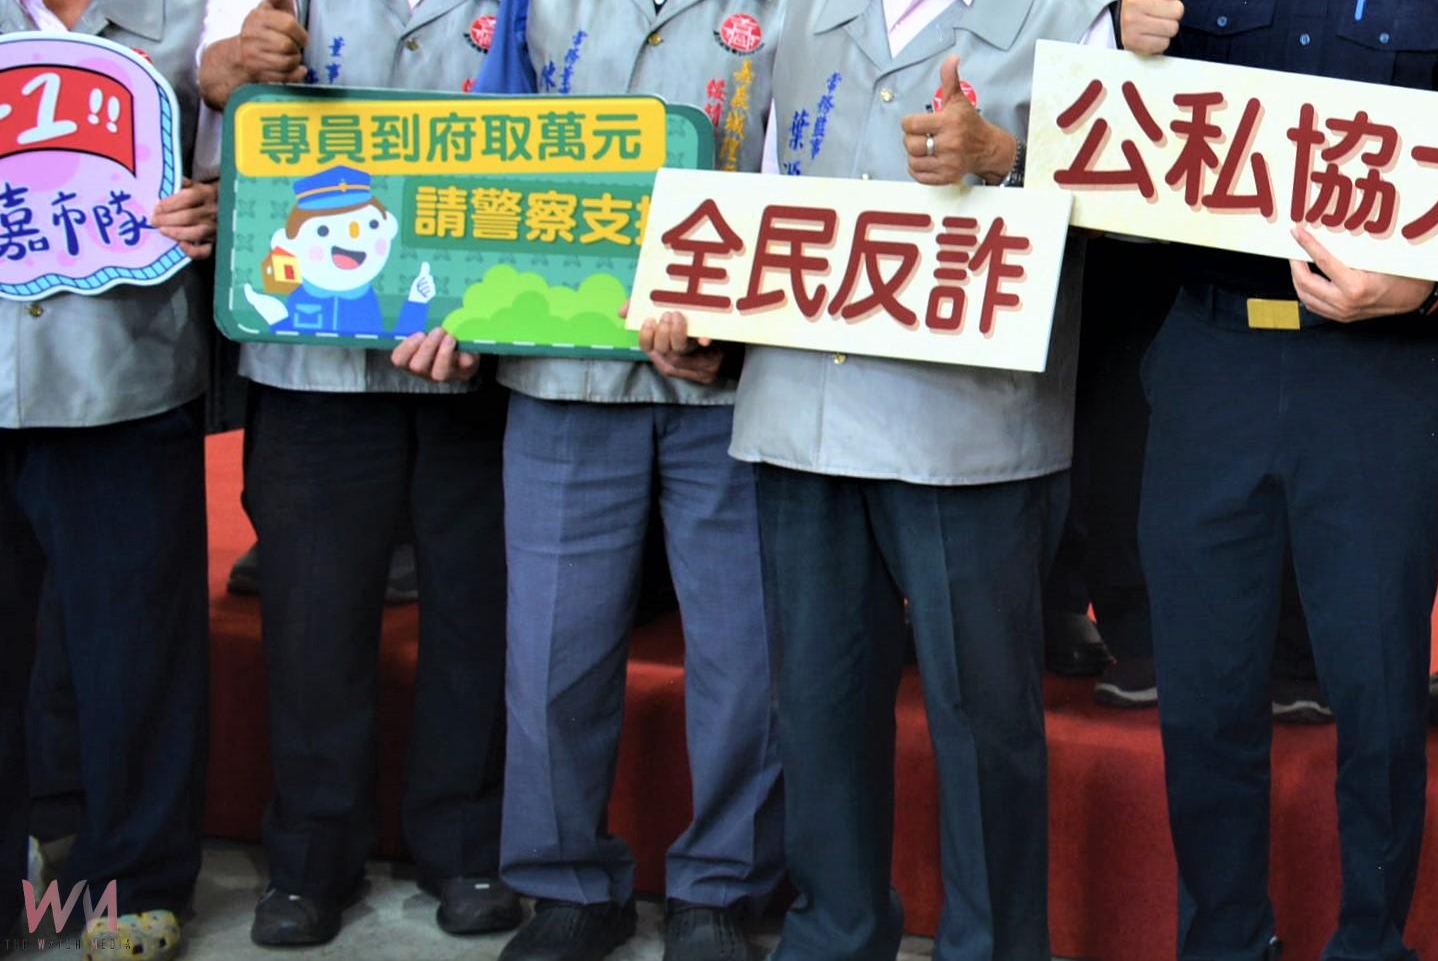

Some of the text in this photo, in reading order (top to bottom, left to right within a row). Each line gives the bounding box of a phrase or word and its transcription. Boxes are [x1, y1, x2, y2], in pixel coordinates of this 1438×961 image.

[258, 111, 642, 164] 專員到府取萬元
[0, 182, 158, 261] 嘉市隊
[649, 198, 1032, 336] 全民反詐
